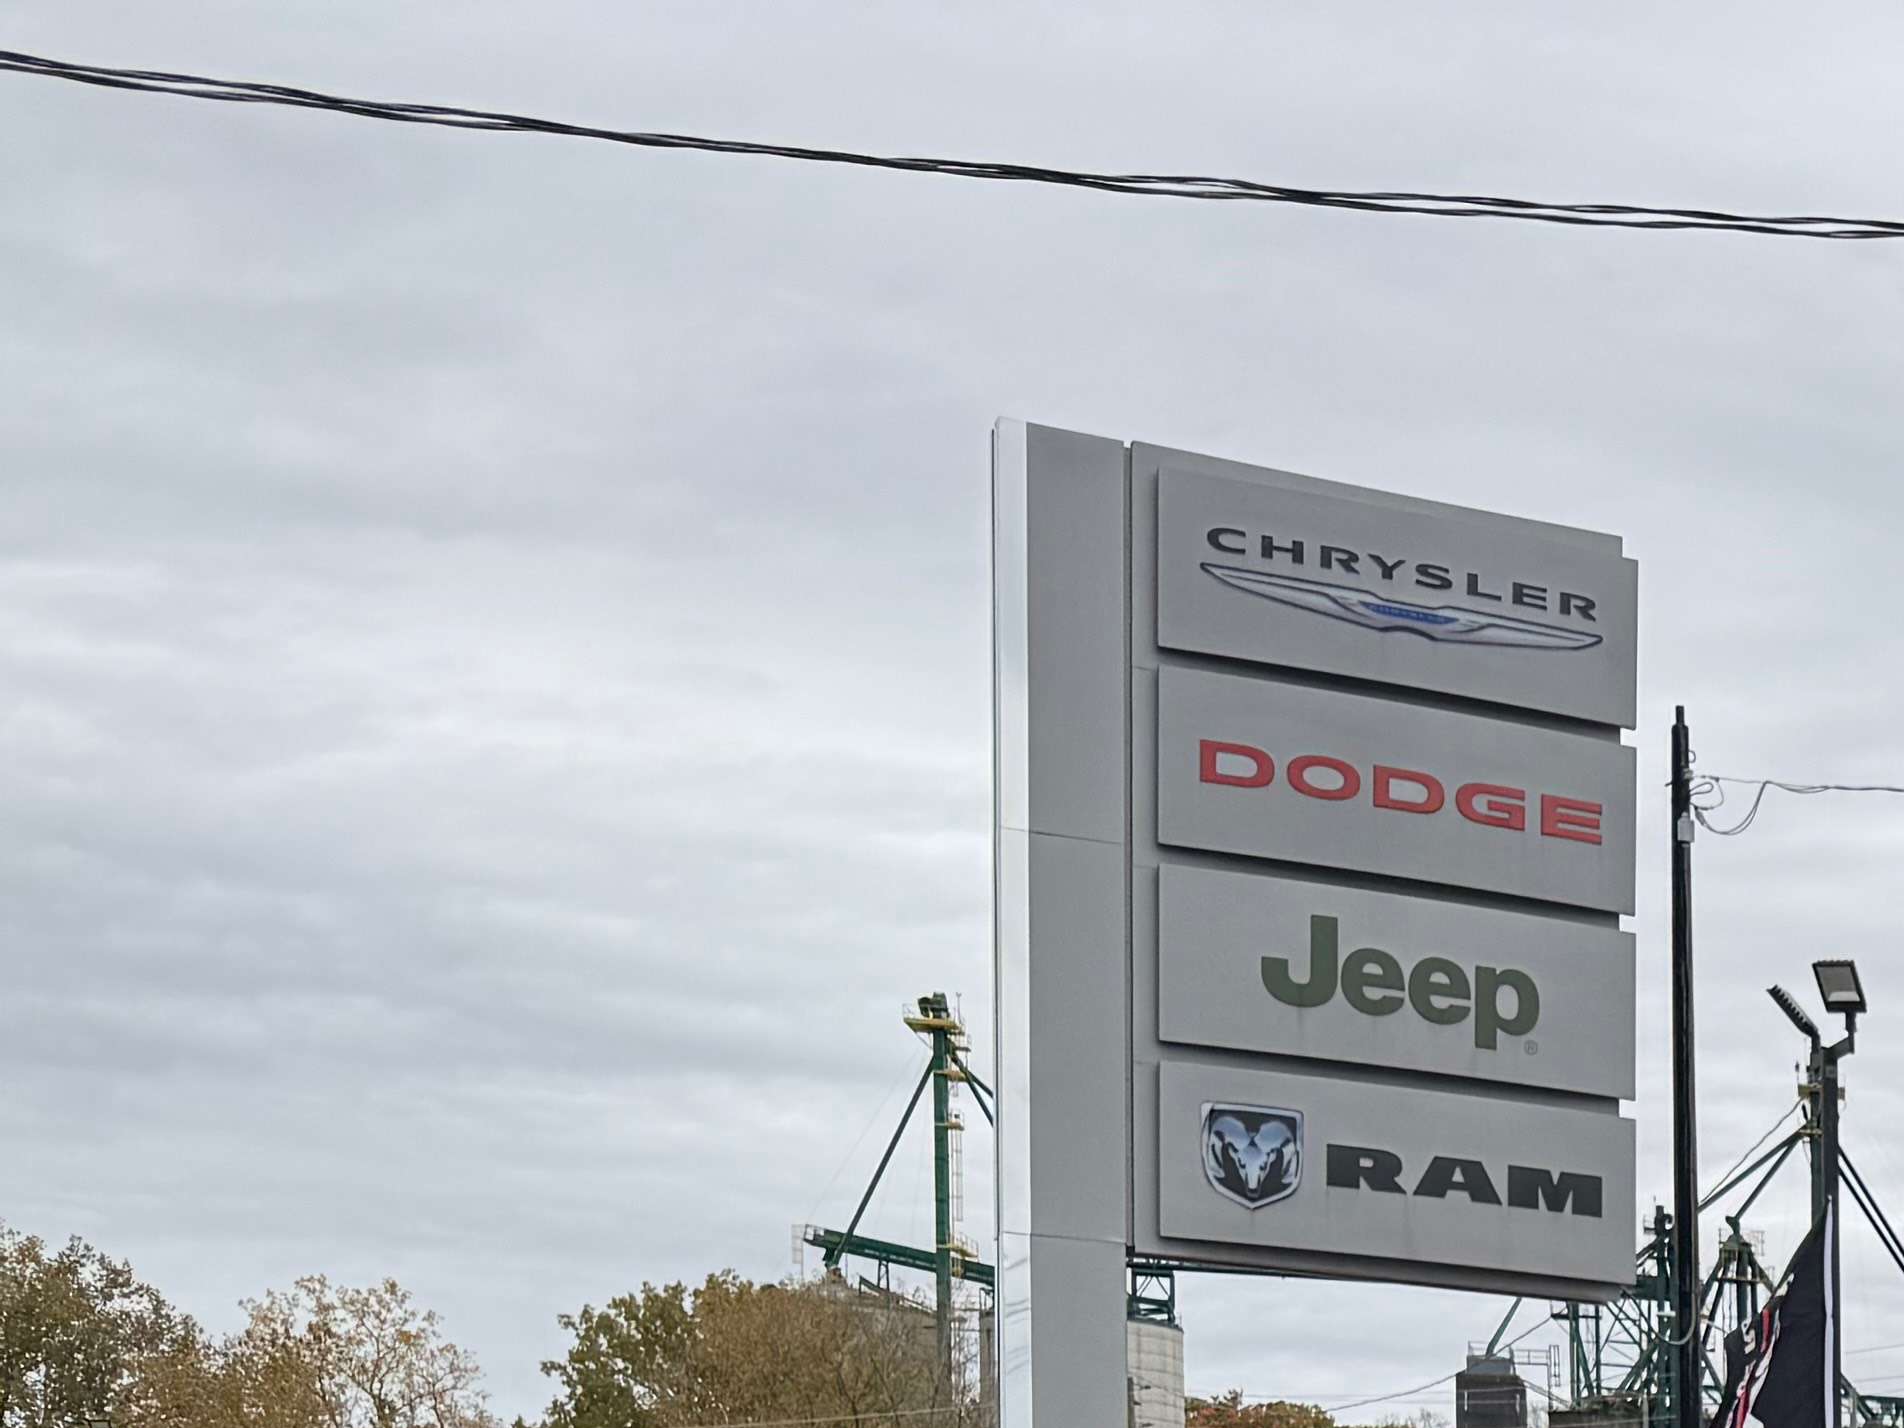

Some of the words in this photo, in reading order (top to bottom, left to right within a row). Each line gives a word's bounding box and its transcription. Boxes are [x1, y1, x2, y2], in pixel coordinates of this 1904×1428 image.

[1206, 527, 1597, 621] CHRYSLER
[1200, 739, 1602, 846] DODGE
[1261, 914, 1540, 1050] Jeep
[1326, 1143, 1602, 1218] RAM
